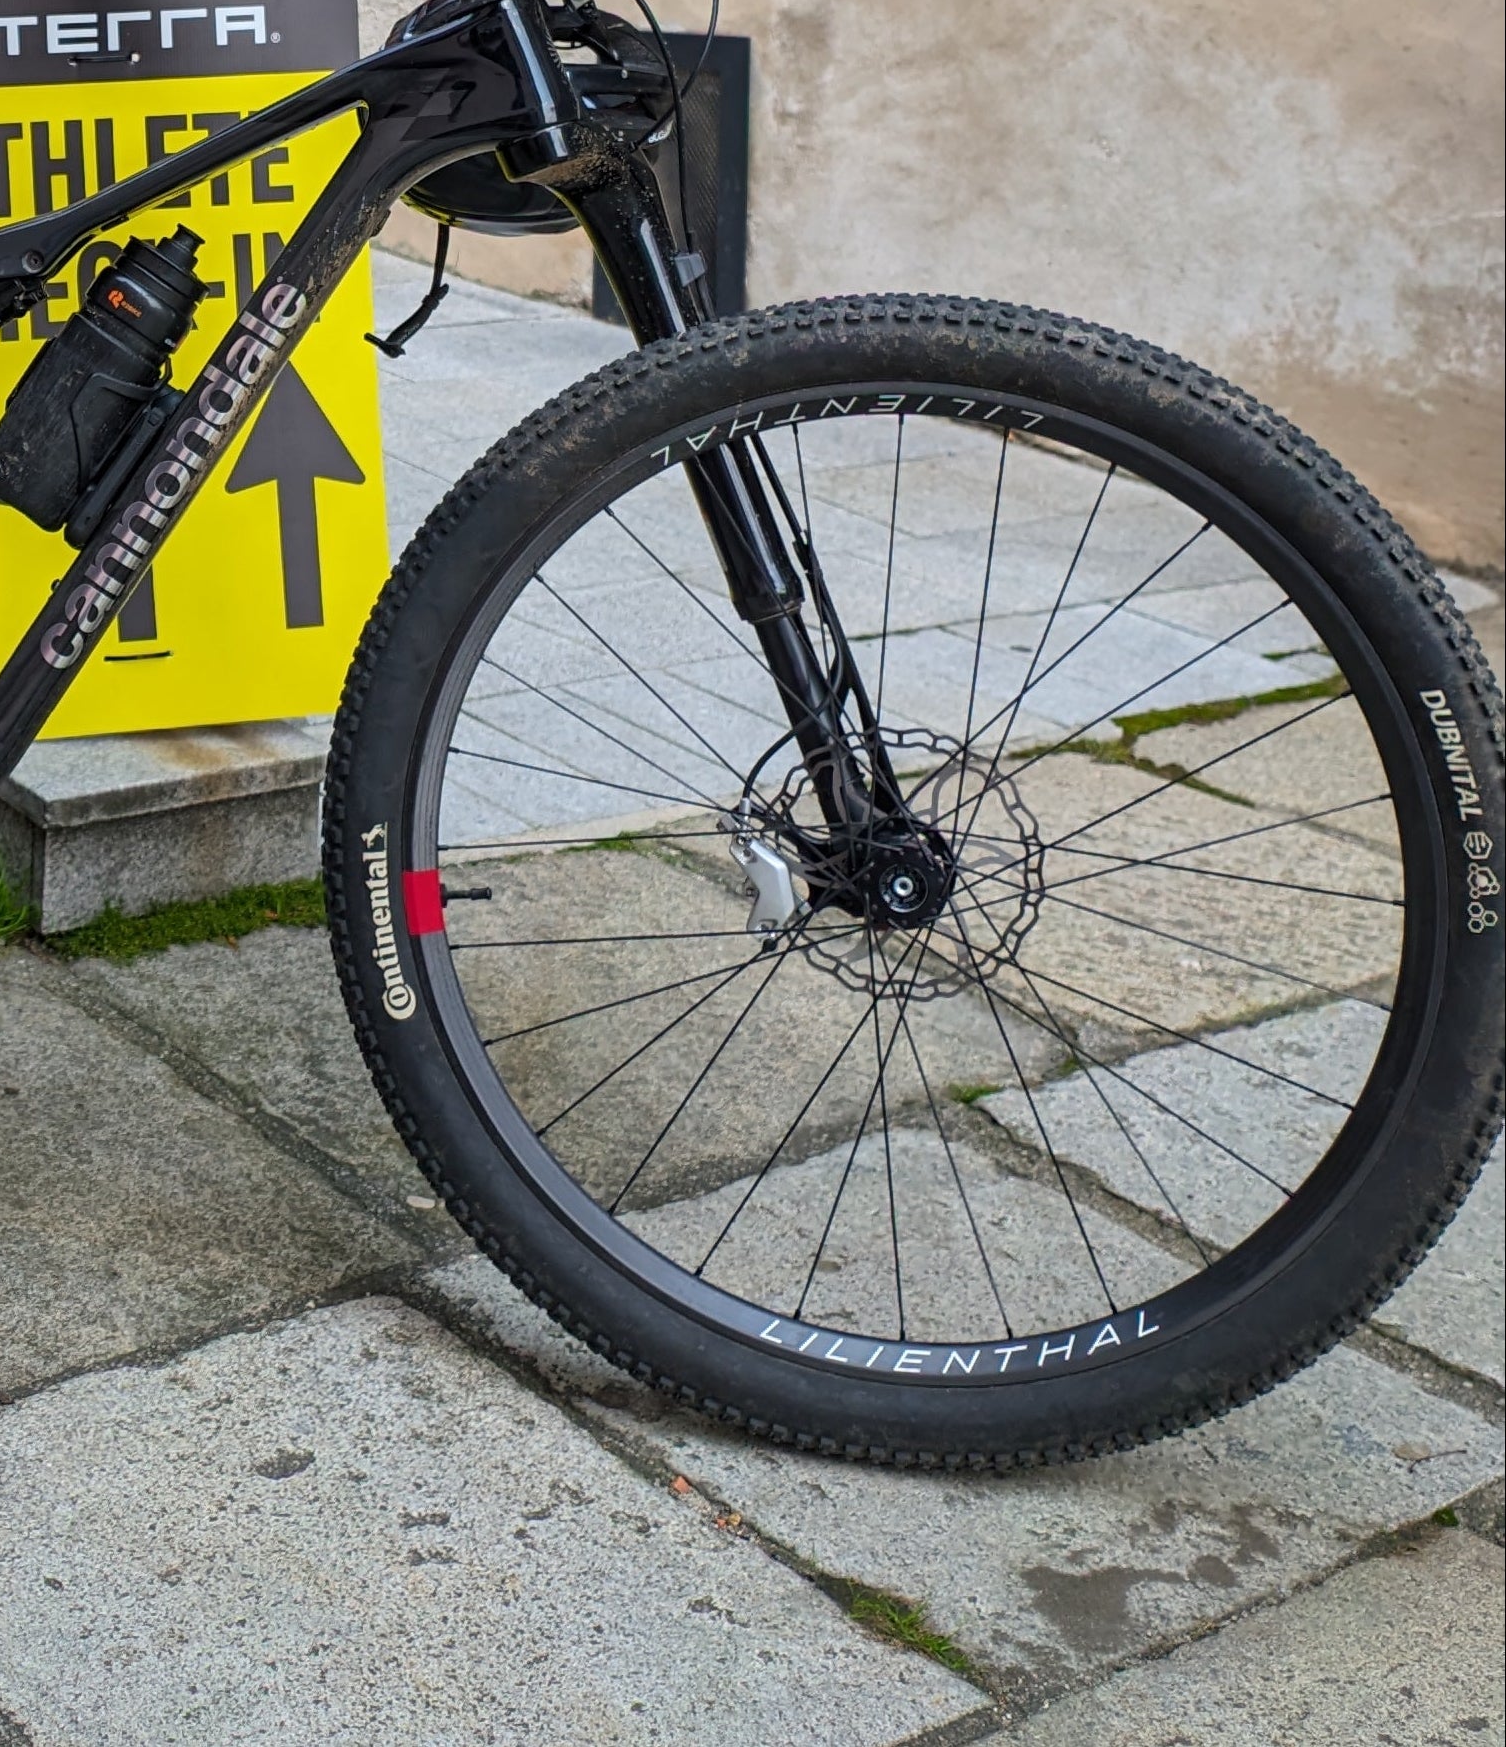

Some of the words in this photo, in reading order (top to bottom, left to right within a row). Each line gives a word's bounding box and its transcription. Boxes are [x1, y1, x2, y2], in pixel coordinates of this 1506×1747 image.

[40, 282, 307, 670] cannondale
[650, 394, 1046, 466] LILIENTHAL
[1419, 688, 1484, 822] DUBNITAL
[362, 850, 417, 1021] Continental
[759, 1310, 1161, 1375] LILIENTHAL
